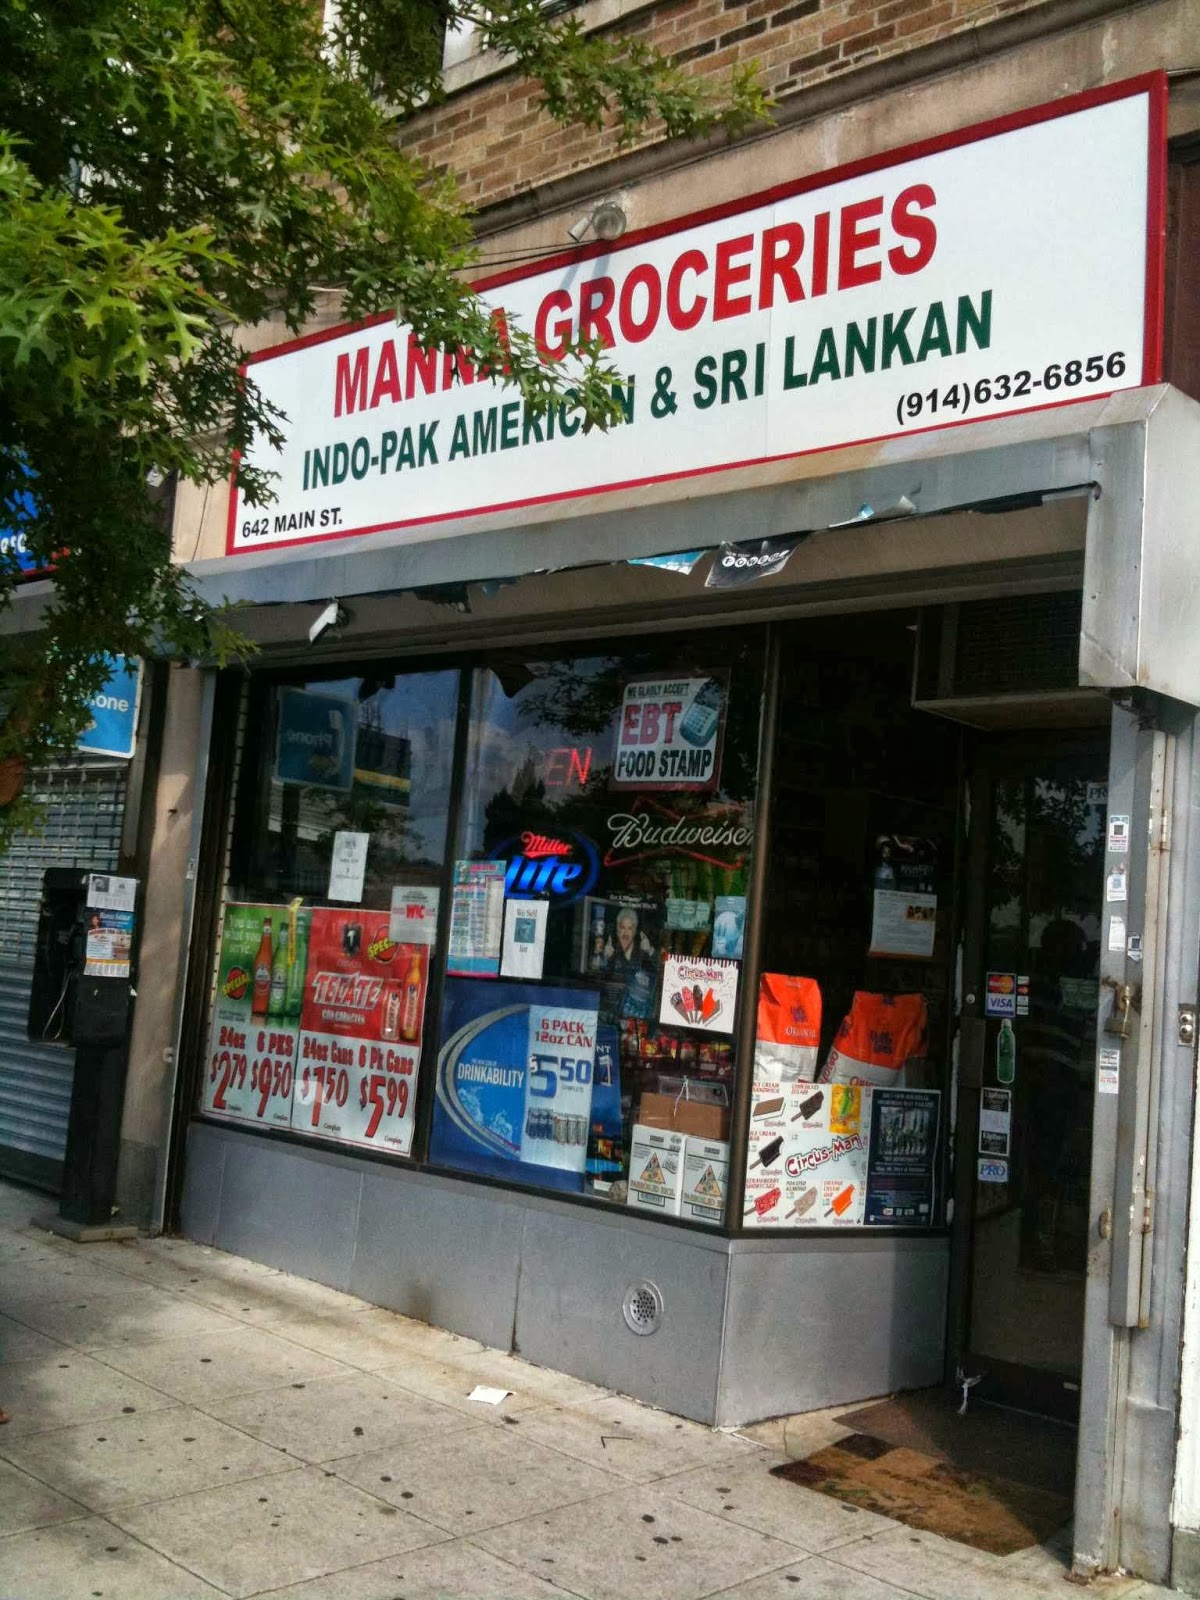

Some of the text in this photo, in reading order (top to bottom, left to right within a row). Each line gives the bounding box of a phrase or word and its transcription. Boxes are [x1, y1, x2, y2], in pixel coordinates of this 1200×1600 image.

[534, 183, 938, 366] GROCERIES
[302, 289, 993, 491] INDO-PAK AMERICN & SRI LANKAN
[896, 351, 1127, 425] (914)632-6856
[242, 507, 343, 539] 642 MAIN ST.
[621, 702, 683, 746] EBT
[617, 749, 712, 778] FOOD STAMP
[520, 831, 573, 857] Miller
[504, 855, 582, 900] Lite
[990, 997, 1013, 1008] VISA
[219, 1025, 247, 1049] 24oz
[268, 1033, 294, 1057] PKS
[534, 1030, 593, 1048] 12oz CAN
[540, 1018, 586, 1034] 6 PACK
[303, 1036, 329, 1062] 24oz
[331, 1041, 354, 1066] Cans
[386, 1049, 415, 1075] Cans
[456, 1062, 526, 1089] DRINKABILITY
[784, 1132, 865, 1178] Circus-Man
